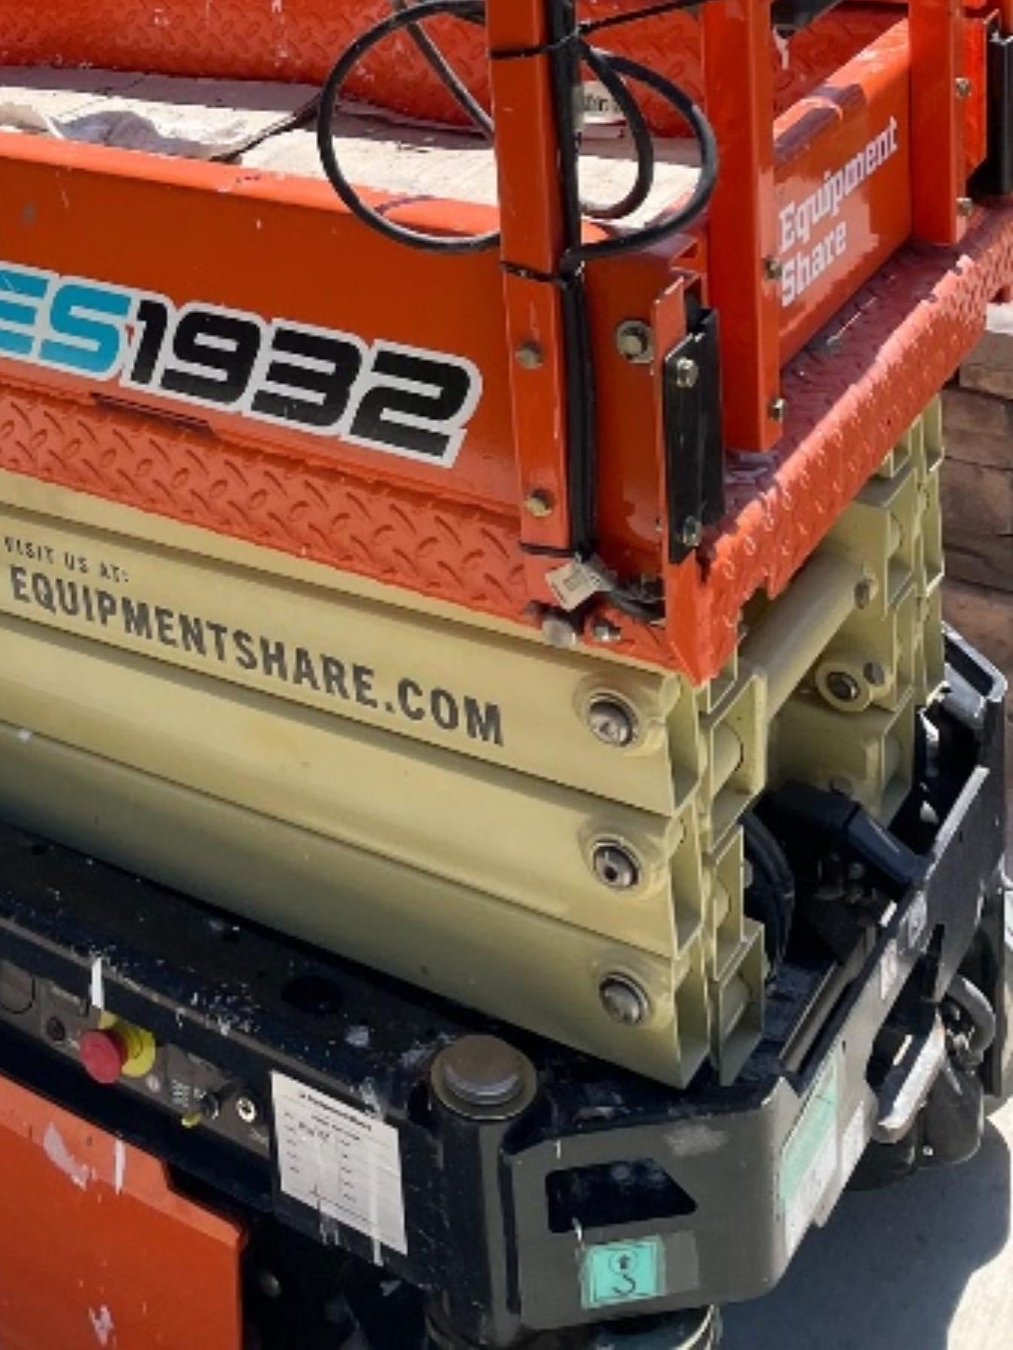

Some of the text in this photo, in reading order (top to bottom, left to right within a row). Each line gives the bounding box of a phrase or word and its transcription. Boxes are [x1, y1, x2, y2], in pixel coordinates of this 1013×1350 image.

[778, 117, 899, 253] Equipment
[779, 220, 848, 307] Share
[3, 536, 54, 564] VISIT
[63, 551, 90, 574] US
[9, 563, 505, 748] EQUIPMENTSHARE.COM
